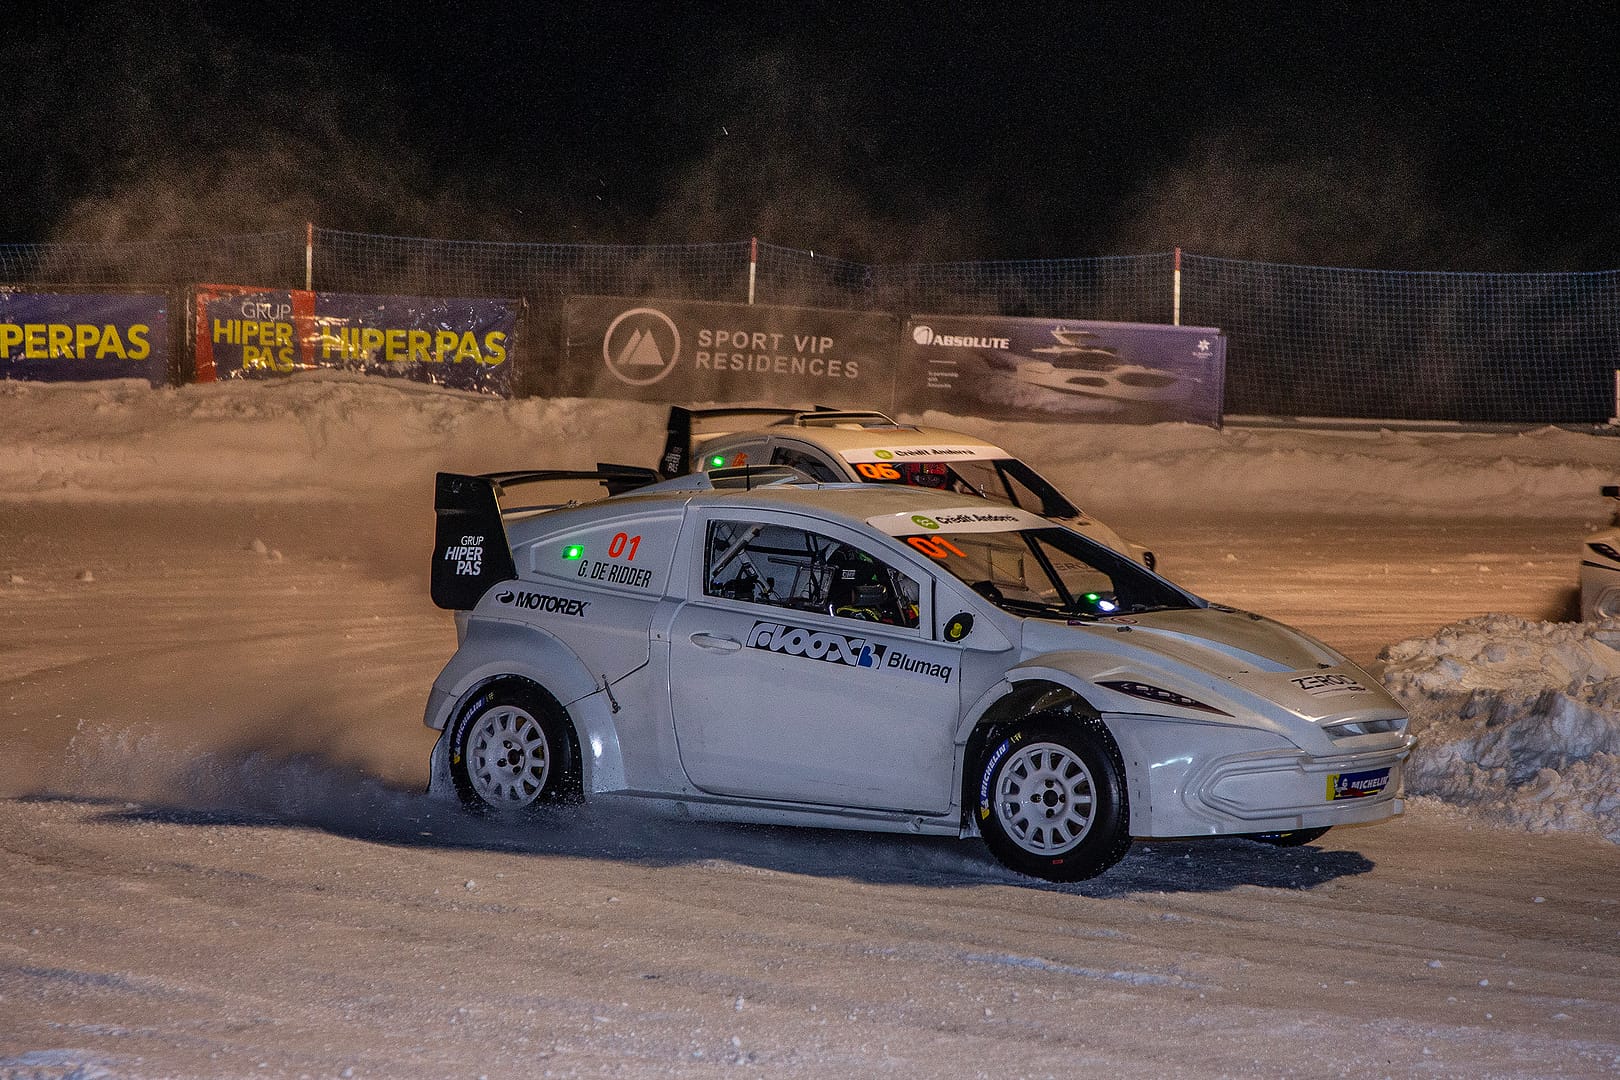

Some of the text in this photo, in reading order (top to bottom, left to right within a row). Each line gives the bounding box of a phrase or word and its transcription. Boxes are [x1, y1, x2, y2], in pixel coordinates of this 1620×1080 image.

[241, 302, 292, 320] GRUP
[213, 318, 294, 348] HIPER
[698, 329, 834, 355] SPORT VIP
[933, 335, 1011, 350] ABSOLUTE
[242, 345, 294, 374] PAS
[321, 326, 507, 367] HIPERPAS
[695, 352, 860, 379] RESIDENCES
[856, 462, 901, 480] 06
[444, 546, 484, 561] HIPER
[460, 535, 485, 546] GRUP
[608, 532, 642, 561] 01
[906, 536, 968, 559] 01
[456, 560, 482, 576] PAS
[578, 560, 652, 588] G. DE RIDDER
[515, 591, 589, 617] MOTOREX
[888, 652, 953, 684] Blumaq
[980, 744, 1007, 798] MICHELIN
[1351, 775, 1389, 790] MICHELIN
